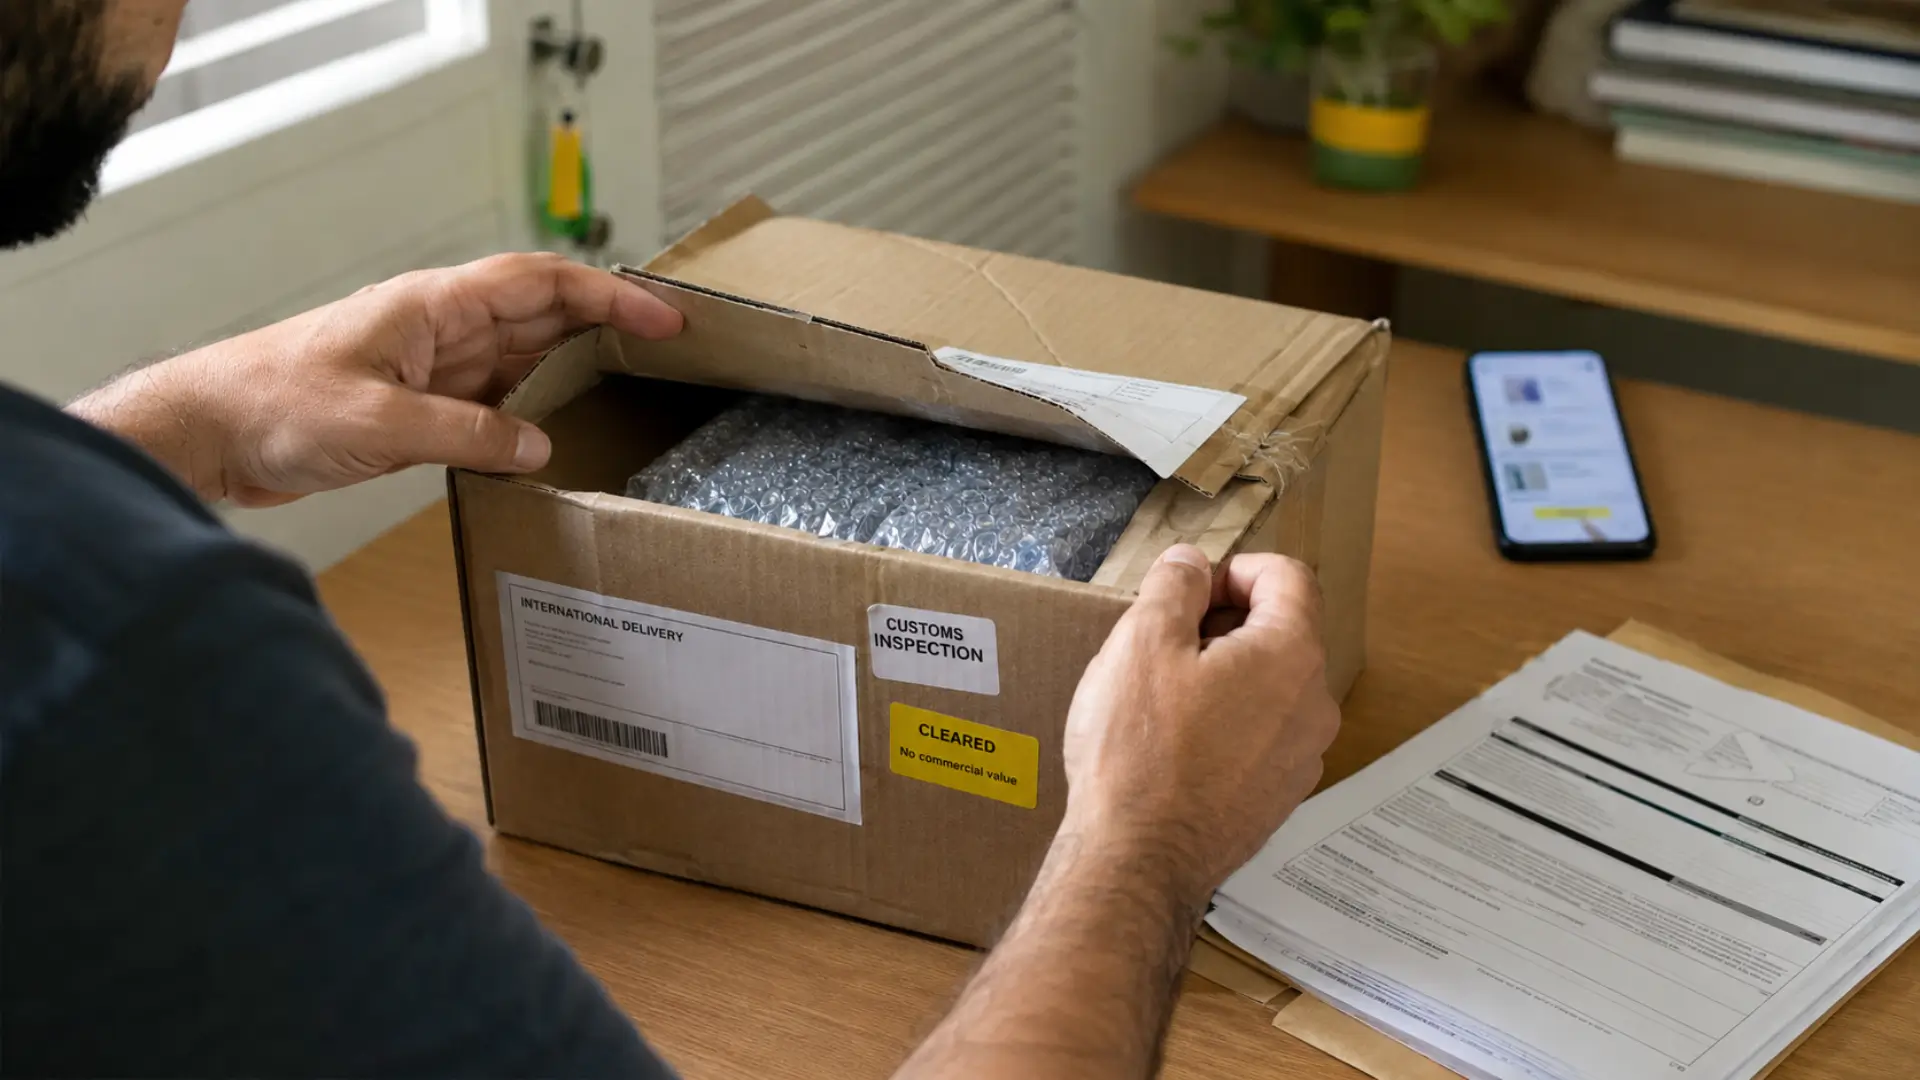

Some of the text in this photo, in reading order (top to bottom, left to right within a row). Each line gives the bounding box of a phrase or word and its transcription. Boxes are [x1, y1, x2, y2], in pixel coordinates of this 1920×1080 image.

[521, 597, 618, 629] INTERNATIONAL
[621, 621, 683, 642] DELIVERY
[887, 618, 963, 640] CUSTOMS
[874, 633, 984, 663] INSPECTION
[918, 723, 996, 754] CLEARED
[900, 747, 1017, 785] No commercial value
